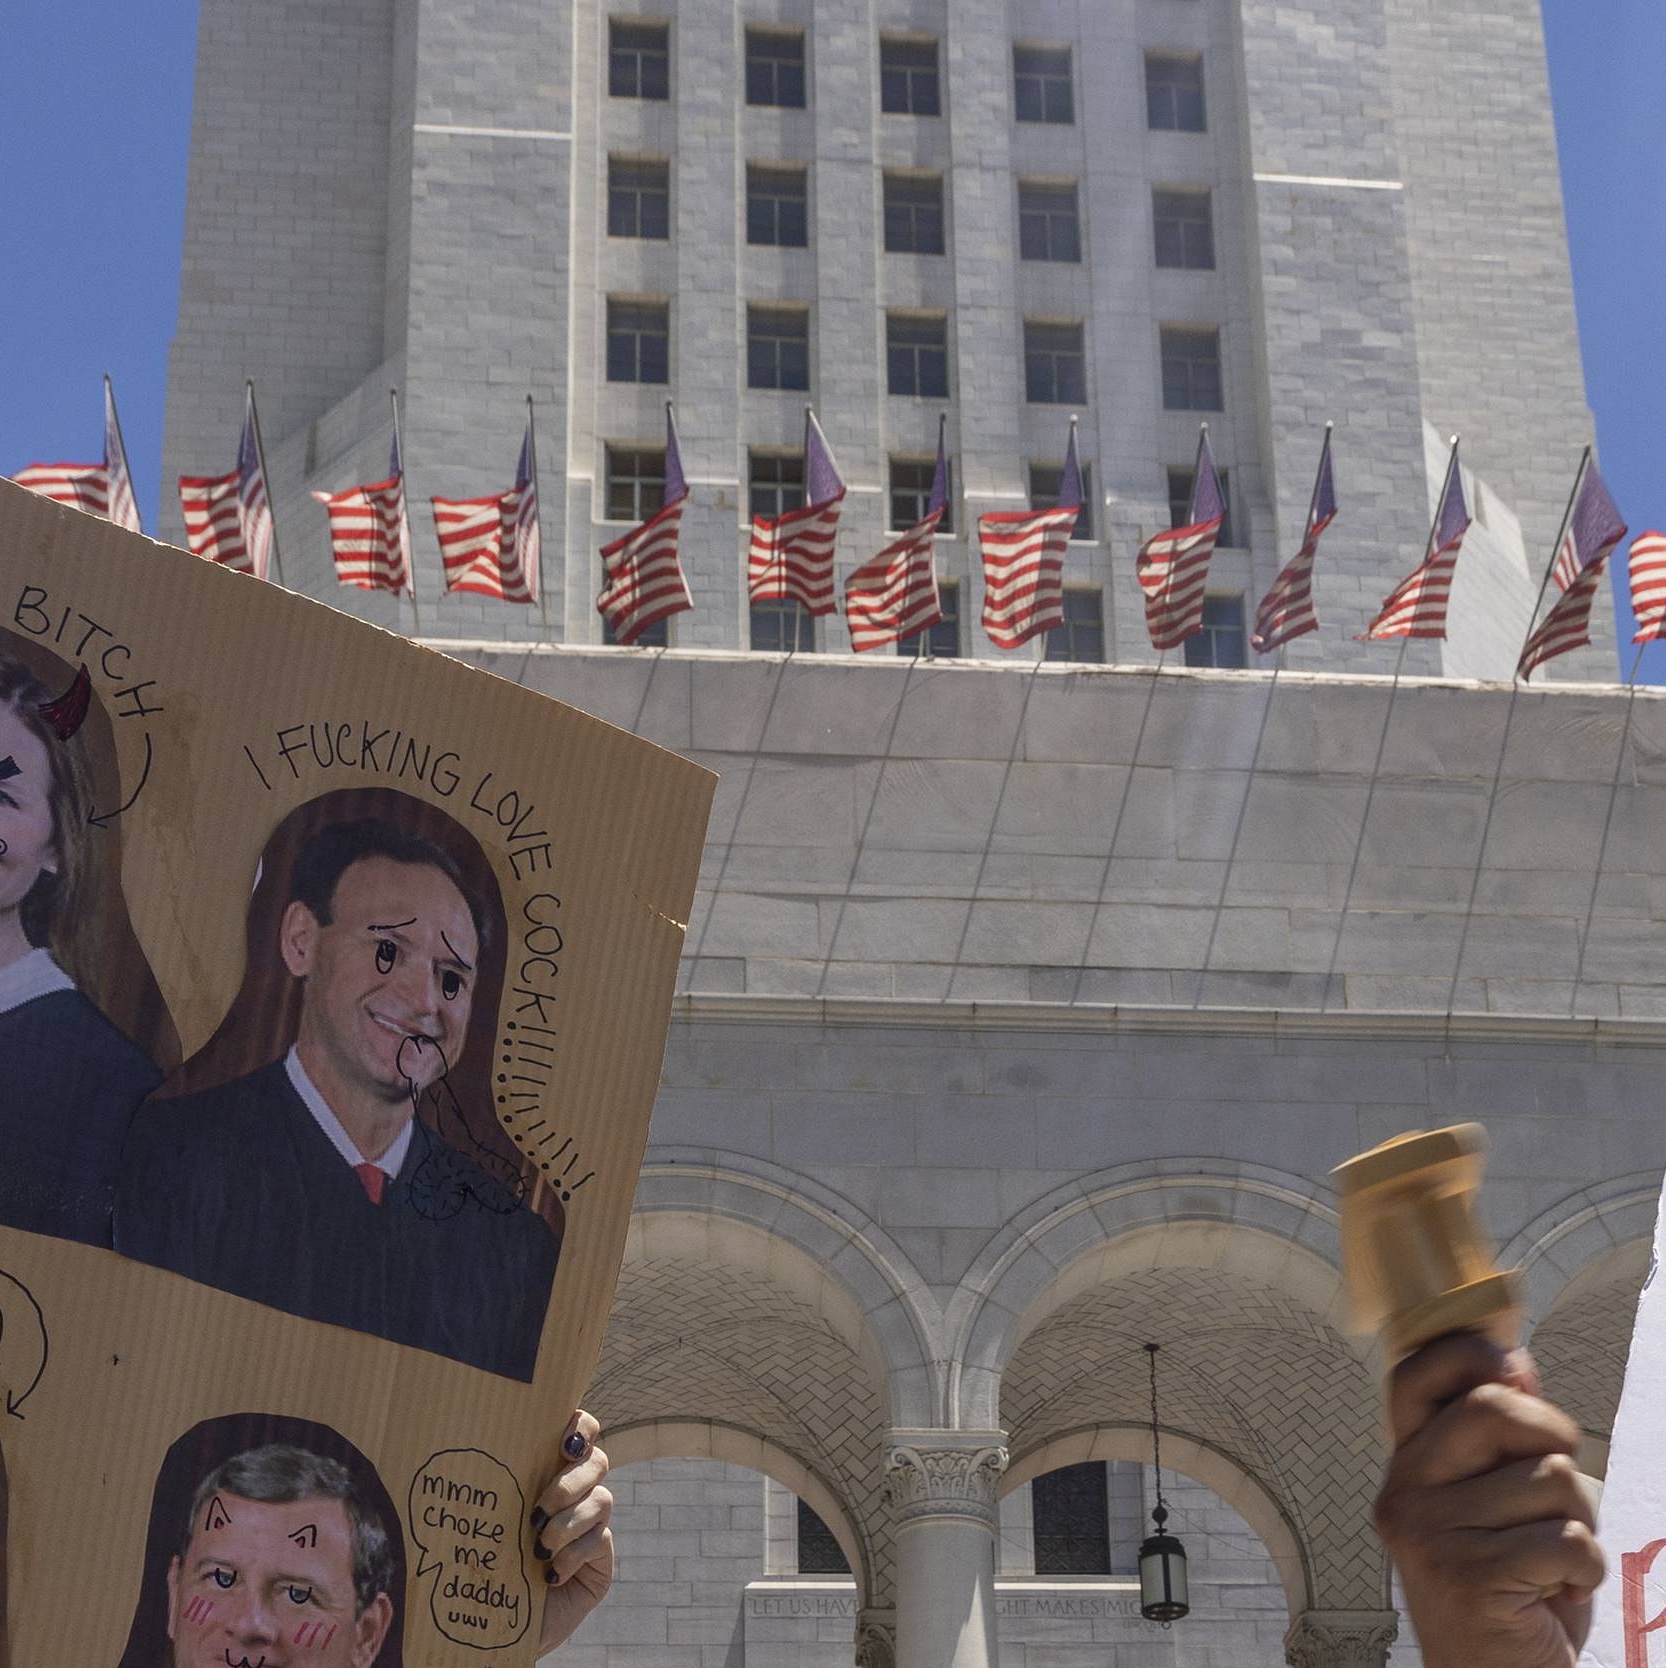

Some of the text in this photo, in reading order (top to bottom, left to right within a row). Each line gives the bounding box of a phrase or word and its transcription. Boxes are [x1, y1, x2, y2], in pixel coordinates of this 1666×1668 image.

[12, 583, 165, 717] BITCH
[242, 743, 271, 791] I
[277, 720, 461, 793] FUCKING
[469, 773, 552, 881] LOVE
[422, 1474, 497, 1511] mmm
[423, 1506, 504, 1543] choke
[454, 1545, 496, 1570] me
[443, 1575, 519, 1629] daddy
